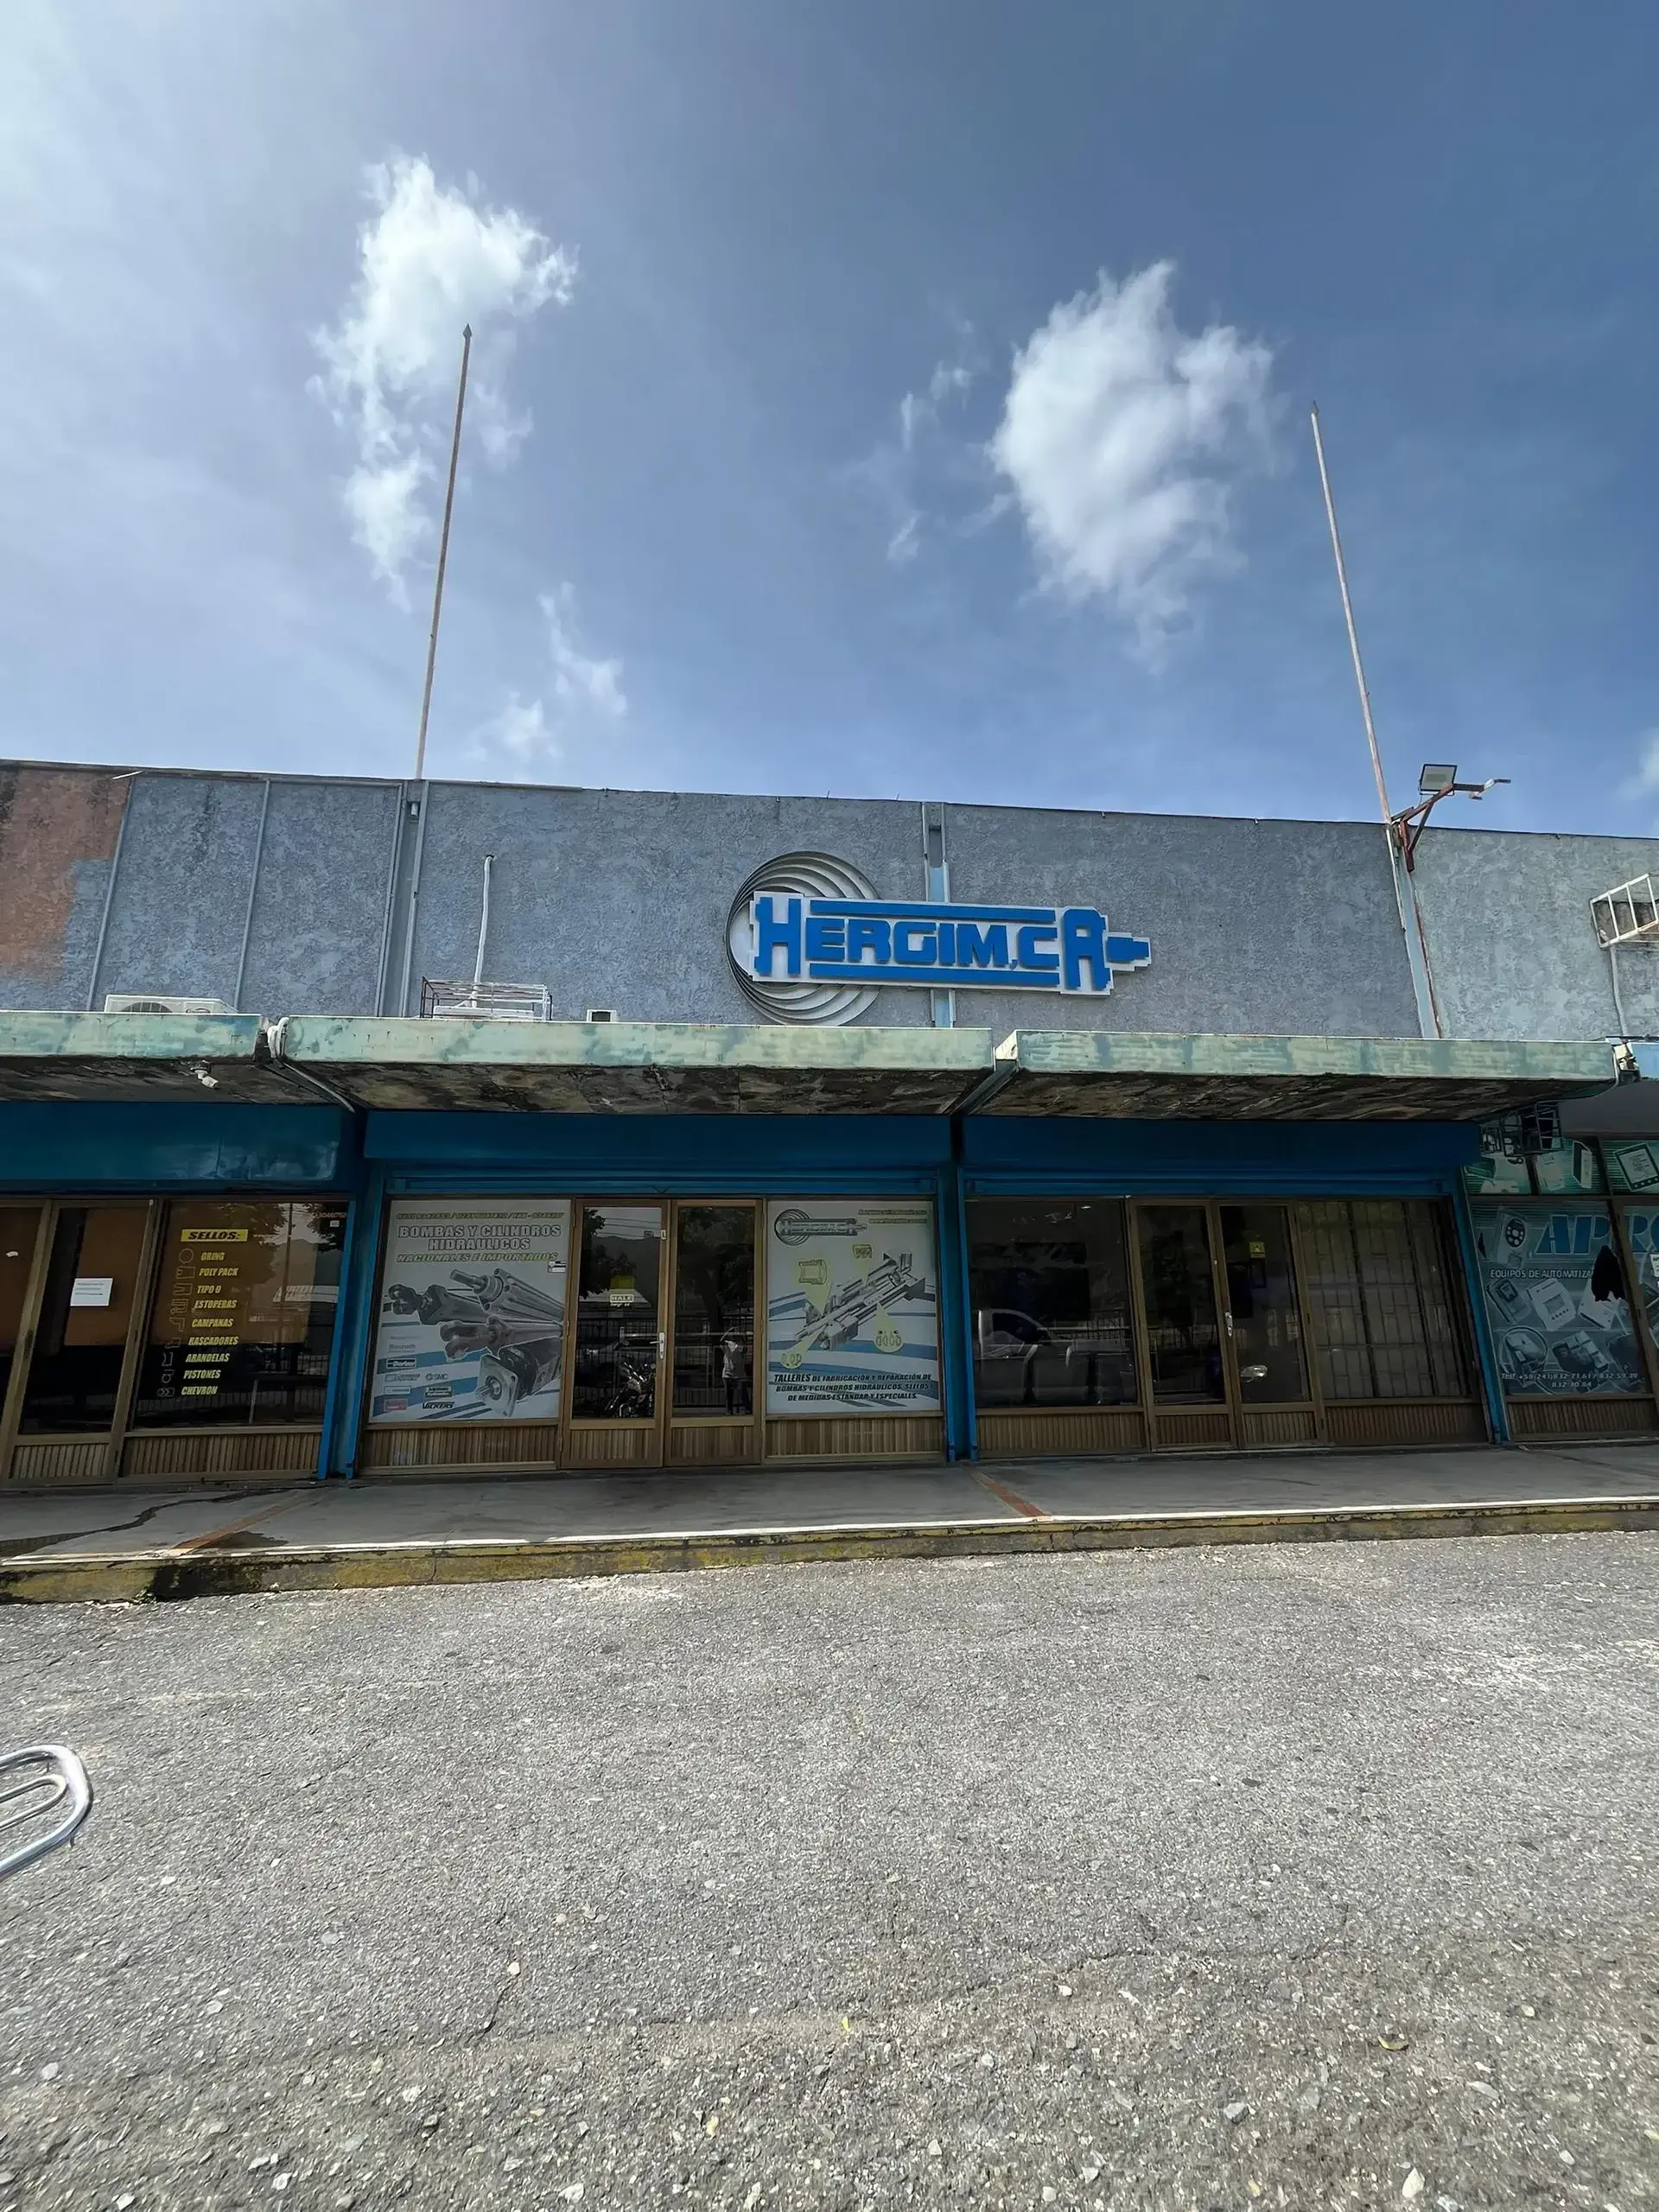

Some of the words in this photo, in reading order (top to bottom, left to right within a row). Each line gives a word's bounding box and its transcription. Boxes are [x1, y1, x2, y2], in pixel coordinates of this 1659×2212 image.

[188, 1231, 241, 1240] SELLOS:
[397, 1225, 465, 1238] BOMBAS
[466, 1225, 478, 1237] Y
[480, 1224, 561, 1237] CILINDROS
[428, 1238, 531, 1251] HIDRAULICOS
[396, 1253, 471, 1263] NACIONALES
[472, 1253, 480, 1262] E
[480, 1252, 558, 1262] IMPORTADOS
[199, 1268, 218, 1276] POLY
[218, 1268, 239, 1276] PACK
[1490, 1269, 1527, 1279] EQUIPOS
[1529, 1269, 1540, 1279] DE
[197, 1285, 214, 1294] TIPO
[214, 1285, 222, 1294] U
[194, 1300, 238, 1309] ESTOPERAS
[191, 1318, 234, 1328] CAMPANAS
[188, 1336, 239, 1346] RASCADORES
[185, 1352, 231, 1363] ARANDELAS
[182, 1370, 222, 1380] PISTONES
[774, 1374, 811, 1382] TALLERES
[181, 1385, 219, 1395] CHEVRON
